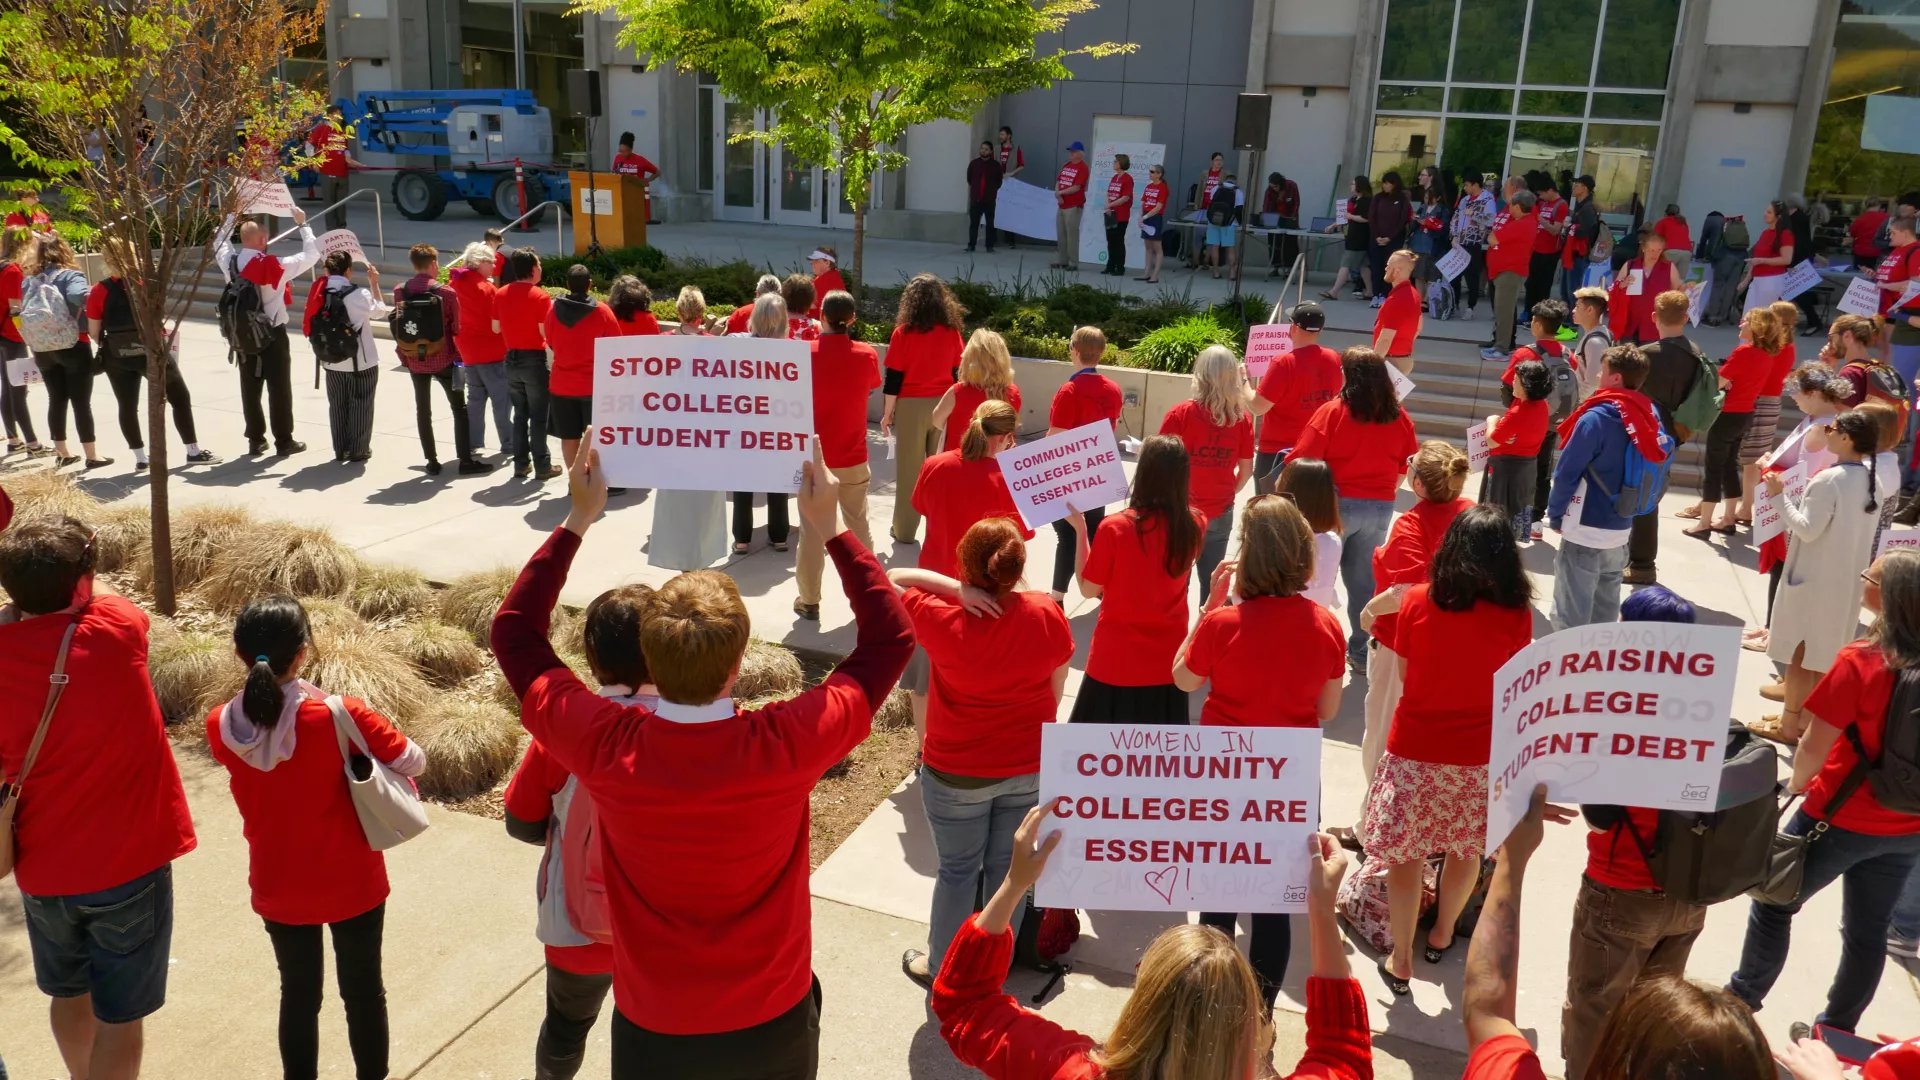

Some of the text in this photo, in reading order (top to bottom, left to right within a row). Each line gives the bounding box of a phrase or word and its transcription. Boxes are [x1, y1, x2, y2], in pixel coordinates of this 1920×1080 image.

[324, 234, 344, 245] PART
[1251, 331, 1291, 340] STOP RAISIN
[1254, 343, 1285, 351] COLLEGE
[609, 357, 799, 382] STOP RAISING
[643, 392, 770, 415] COLLEGE
[599, 426, 809, 452] STUDENT DEBT
[1013, 435, 1100, 472] COMMUNITY
[1012, 450, 1116, 492] COLLEGES ARE
[1031, 474, 1107, 506] ESSENTIAL
[1790, 485, 1804, 499] ARE
[1502, 649, 1715, 714] STOP RAISING
[1516, 691, 1660, 735] COLLEGE
[1110, 728, 1254, 754] WOMEN IN
[1077, 753, 1288, 780] COMMUNITY
[1493, 732, 1715, 802] STUDENT DEBT
[1053, 796, 1307, 823] COLLEGES ARE
[1085, 839, 1272, 865] ESSENTIAL
[1283, 891, 1306, 901] oea
